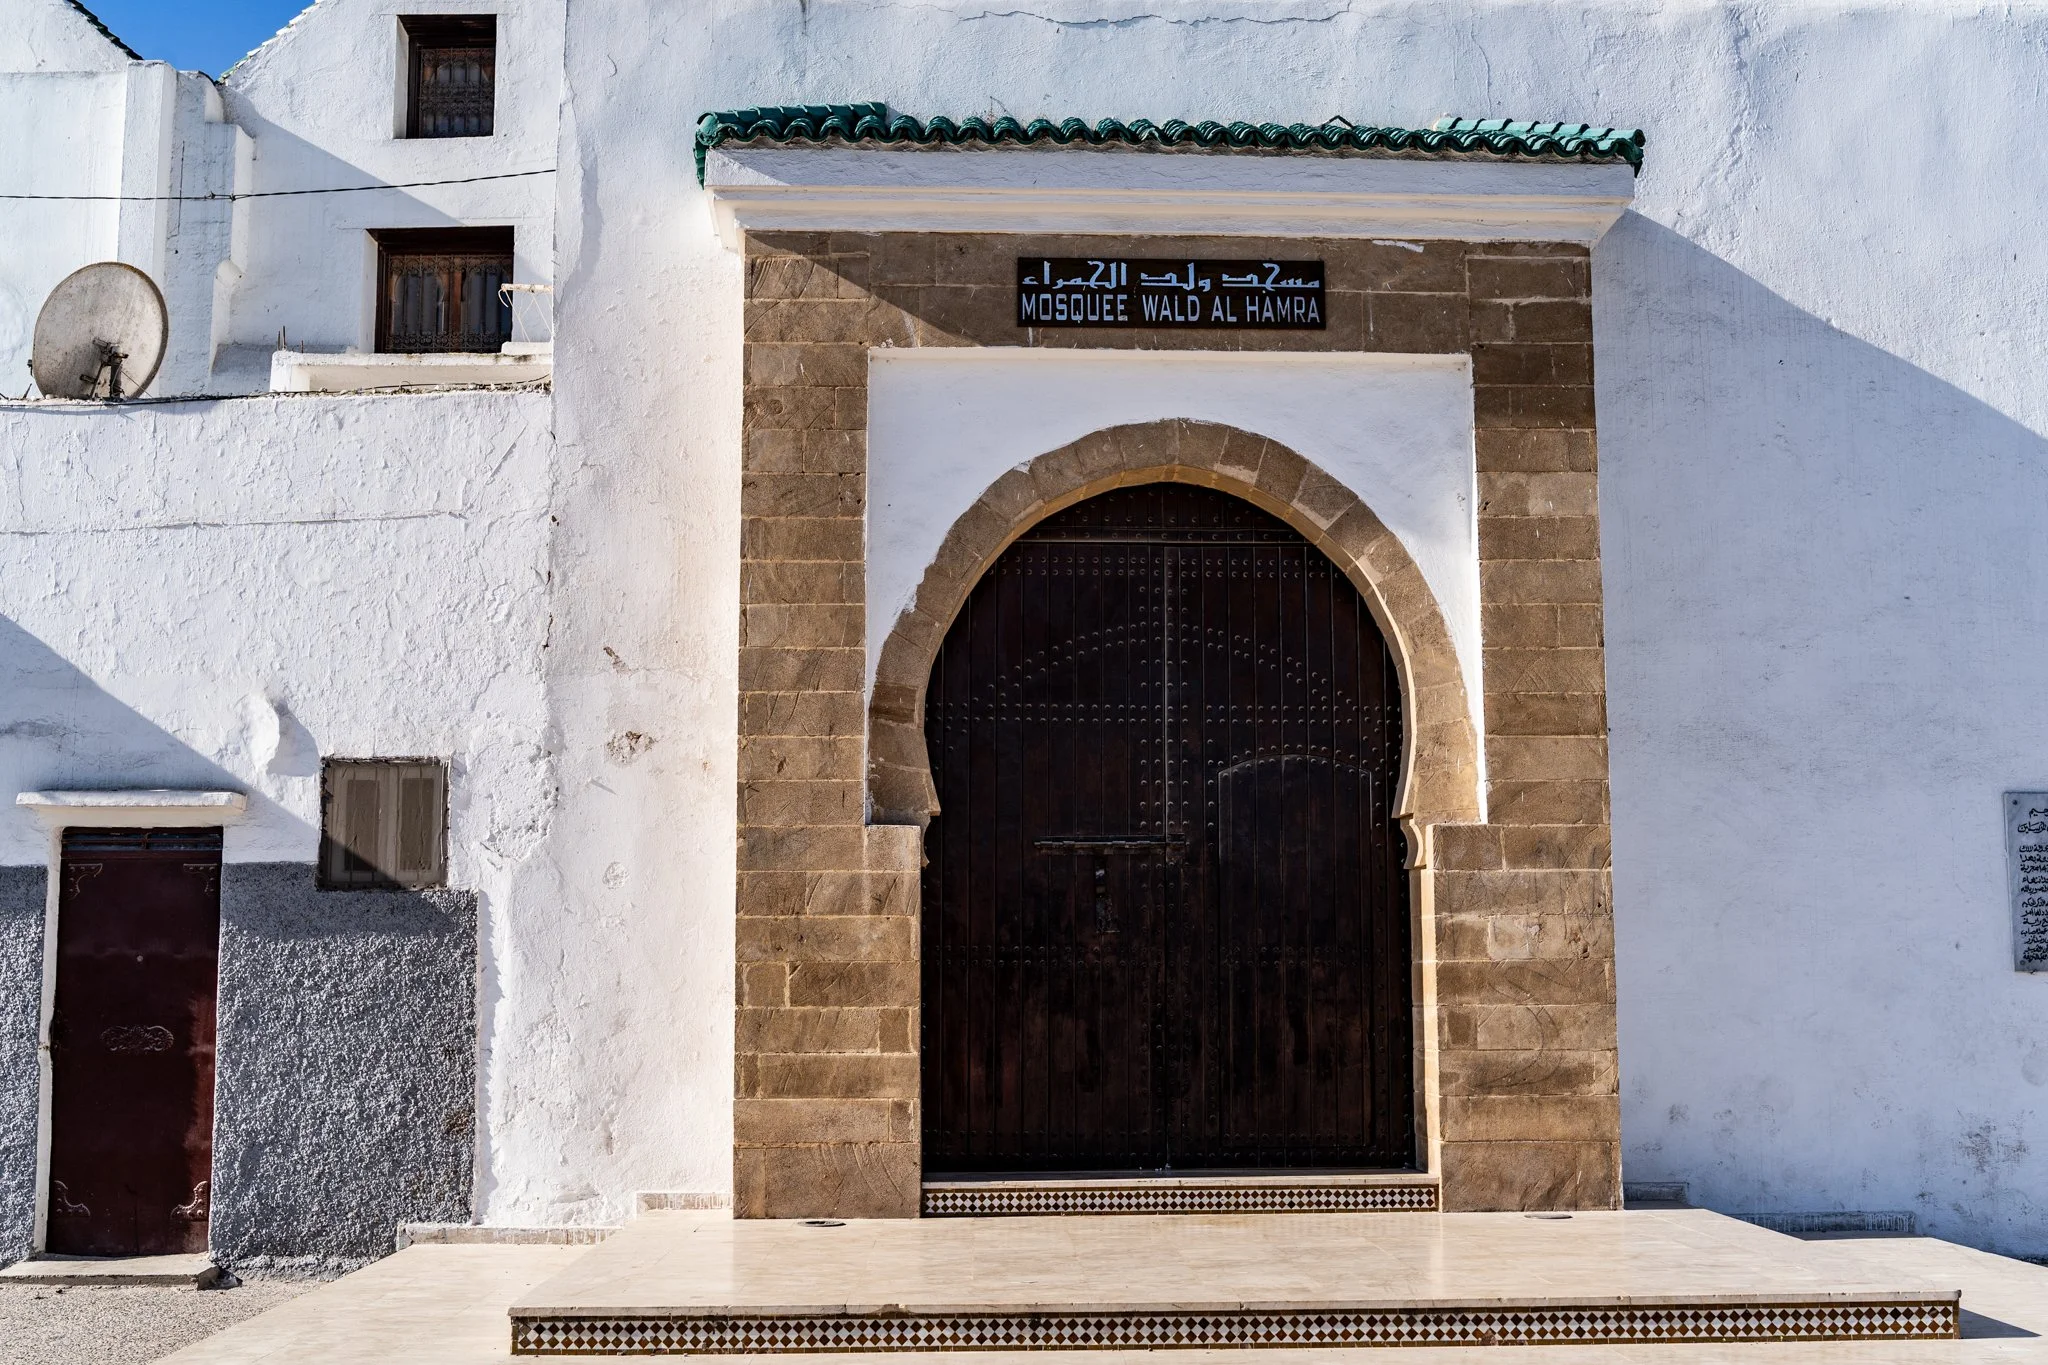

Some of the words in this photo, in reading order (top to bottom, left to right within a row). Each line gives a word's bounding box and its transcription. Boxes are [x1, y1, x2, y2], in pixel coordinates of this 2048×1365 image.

[1022, 260, 1128, 290] الحمراء
[1141, 262, 1211, 292] ولد
[1222, 263, 1320, 293] مسجد
[1022, 293, 1128, 324] MOSQUEE
[1142, 294, 1200, 322] WALD
[1210, 295, 1238, 323] AL
[1246, 295, 1321, 324] HAMRA
